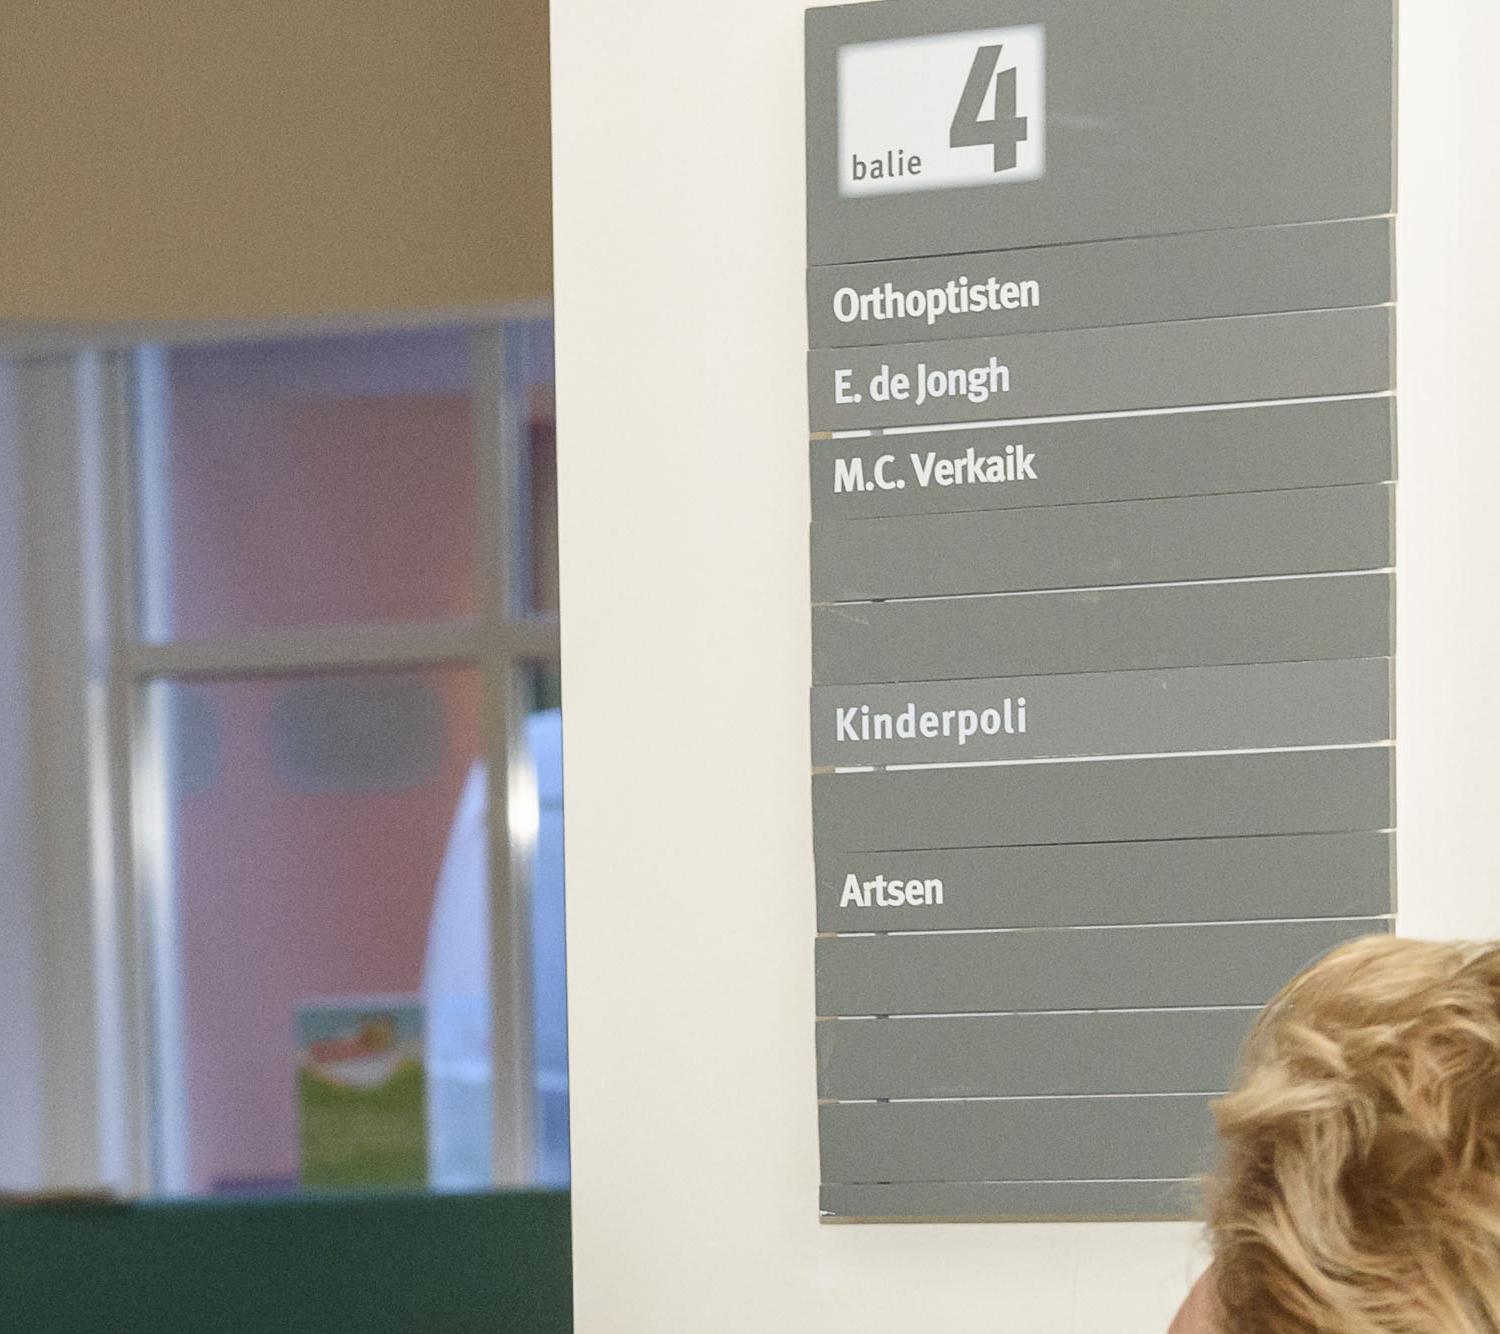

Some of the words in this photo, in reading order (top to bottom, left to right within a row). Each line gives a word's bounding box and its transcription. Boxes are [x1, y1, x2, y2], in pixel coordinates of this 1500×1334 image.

[949, 44, 1028, 173] 4
[851, 150, 923, 182] balie
[833, 277, 1041, 327] Orthoptisten
[834, 370, 862, 405] E.
[870, 365, 911, 402] de
[916, 358, 1010, 406] Jongh
[833, 455, 905, 493] M.C.
[910, 445, 1038, 488] Verkaik
[835, 698, 1027, 745] Kinderpoli
[840, 874, 945, 908] Artsen
